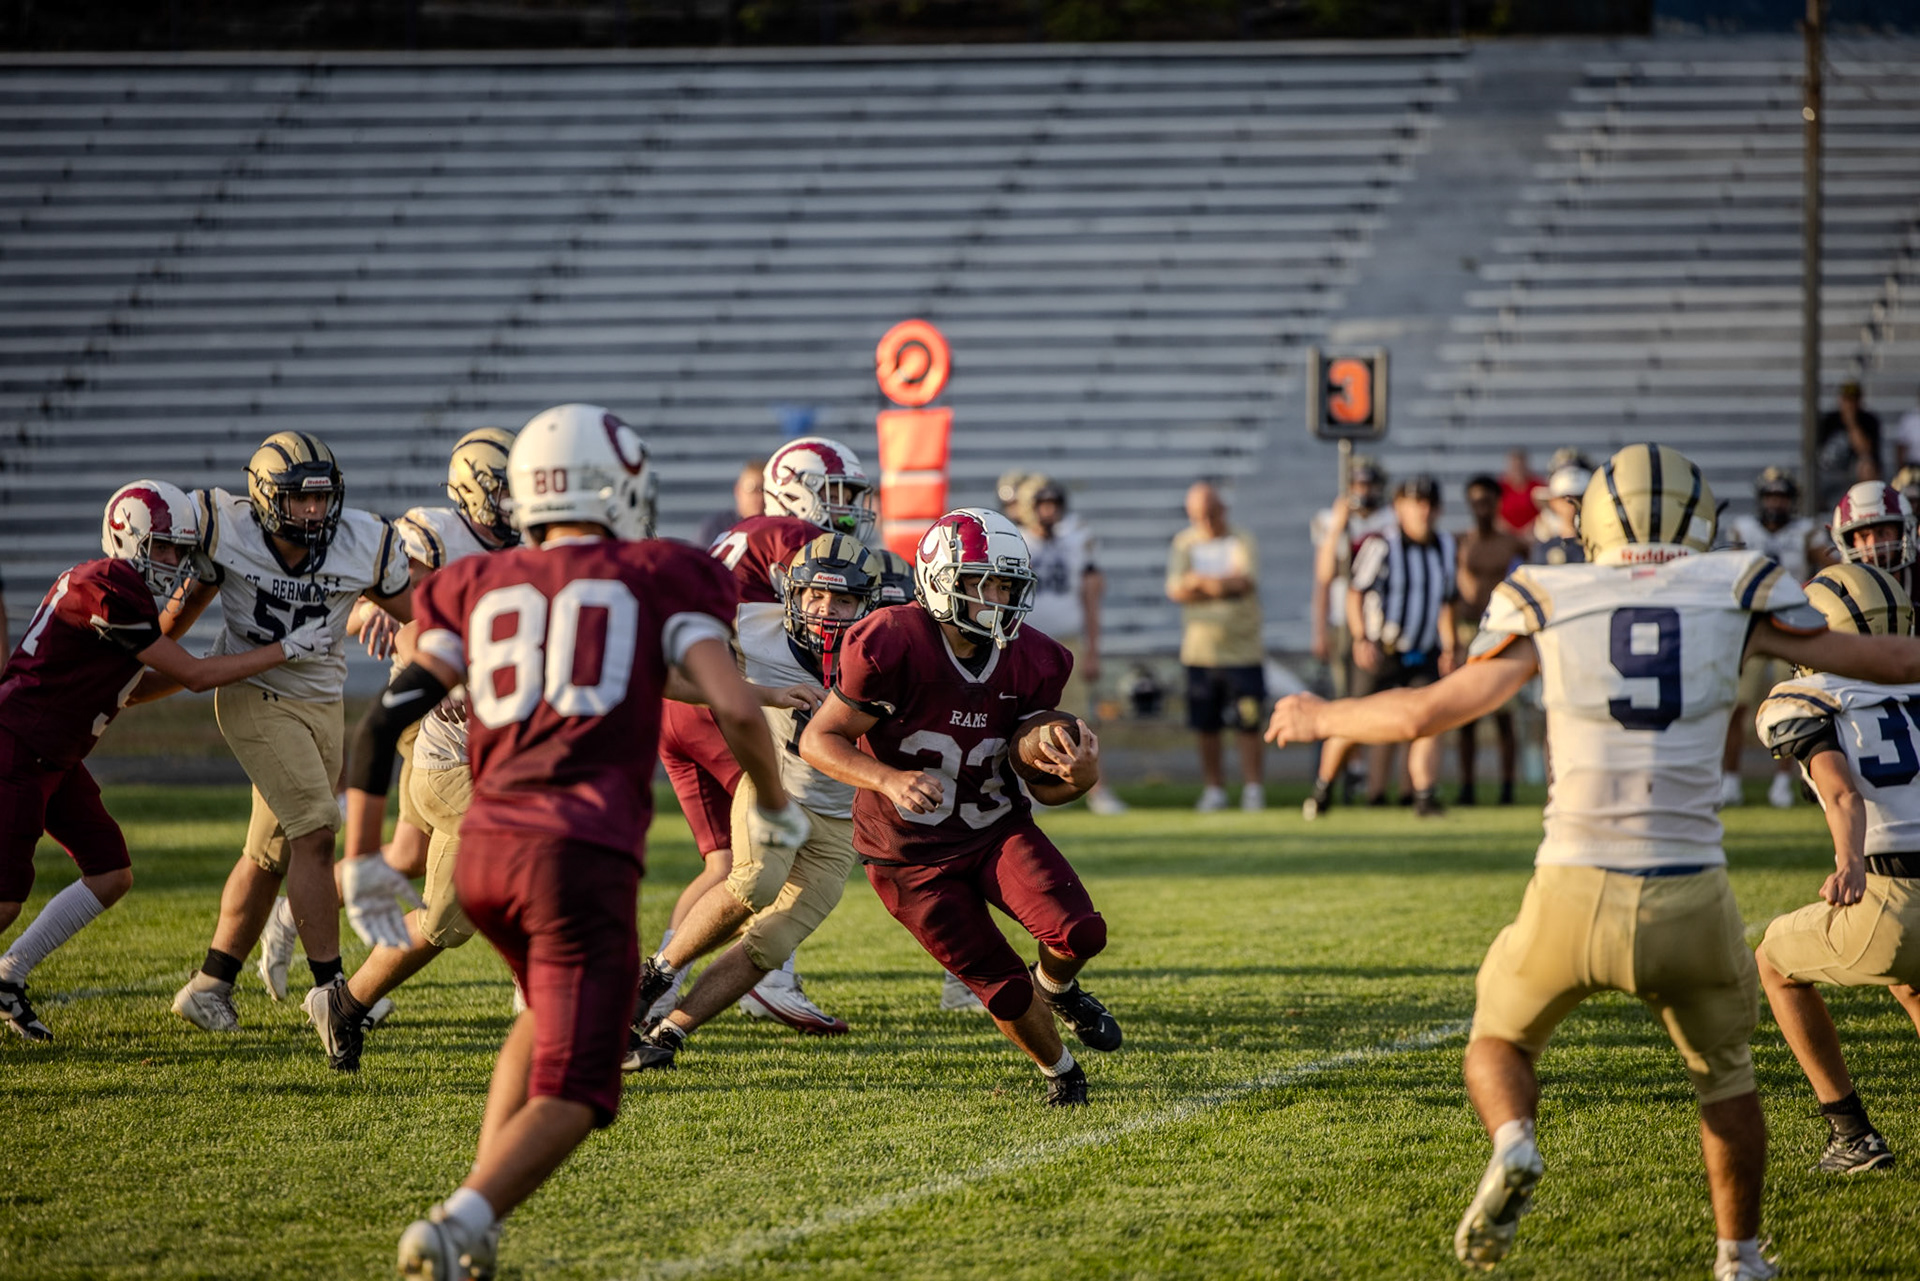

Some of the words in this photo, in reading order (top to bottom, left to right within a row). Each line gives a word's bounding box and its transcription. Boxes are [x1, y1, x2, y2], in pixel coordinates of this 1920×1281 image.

[1328, 357, 1371, 423] 3
[534, 467, 568, 494] 80
[817, 574, 843, 583] Riddell
[468, 579, 639, 730] 80
[1608, 607, 1681, 731] 9
[949, 709, 988, 728] RAMS
[1858, 694, 1920, 788] 3
